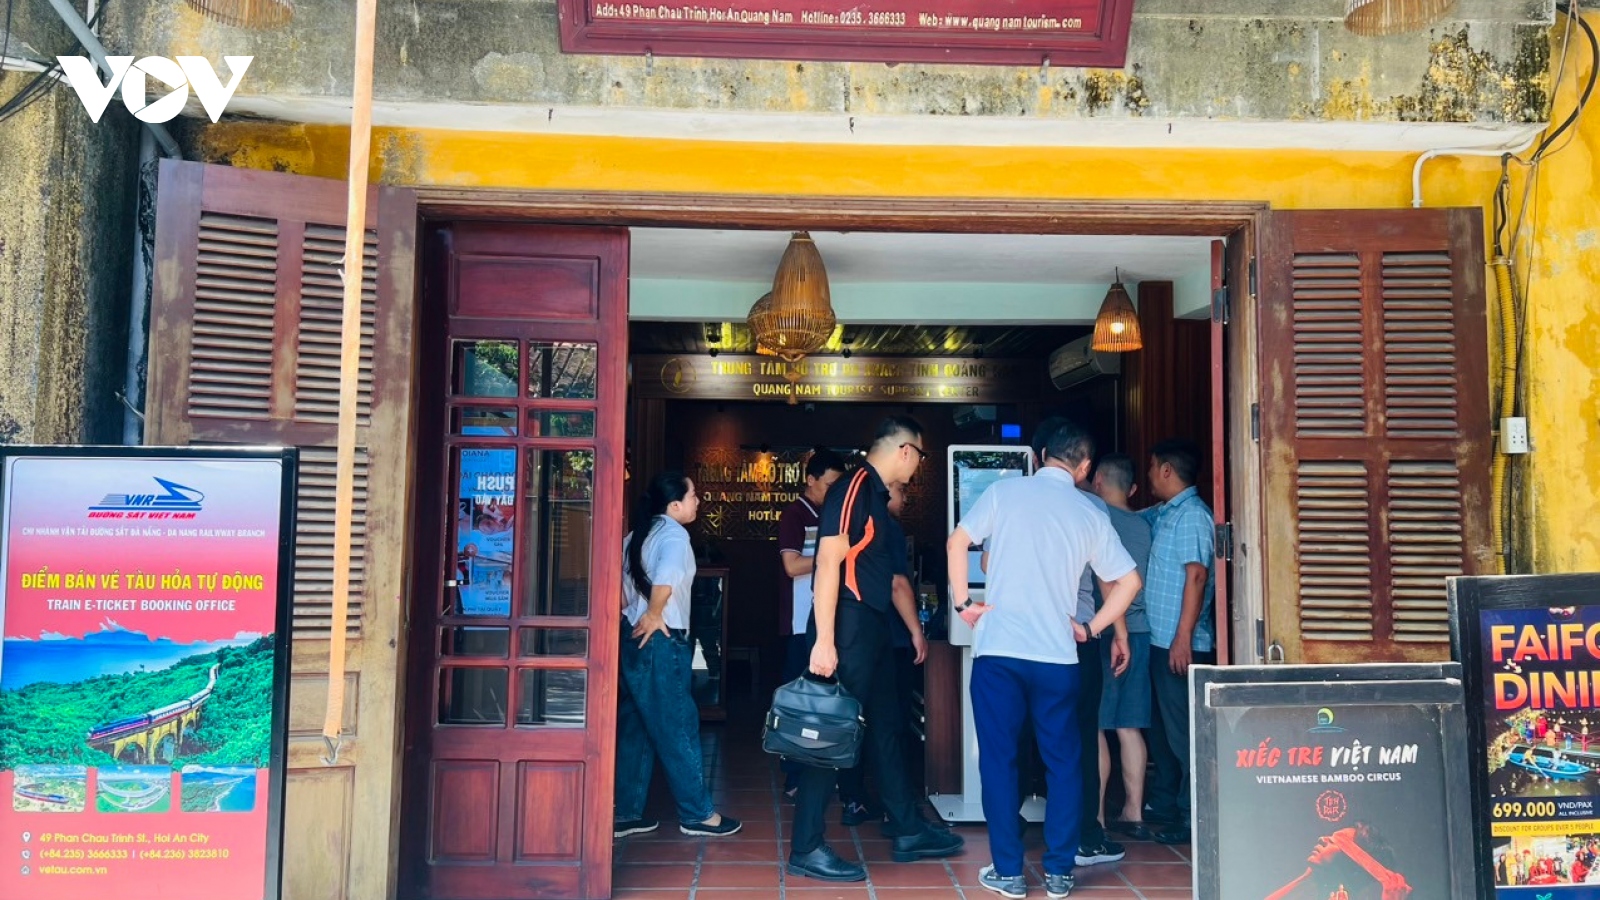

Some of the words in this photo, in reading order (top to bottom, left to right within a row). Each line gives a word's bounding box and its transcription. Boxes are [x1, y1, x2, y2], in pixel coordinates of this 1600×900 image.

[633, 5, 657, 19] Phan
[658, 5, 682, 19] Chau
[772, 10, 793, 23] Nam
[711, 361, 752, 375] TRUNG
[753, 383, 791, 396] QUANG
[795, 384, 821, 395] NAM
[125, 494, 155, 506] VNR
[237, 528, 266, 538] BRANCH
[21, 565, 60, 589] ĐIỂM
[65, 570, 96, 589] BÁN
[101, 570, 120, 589] VÉ
[126, 570, 156, 589] TÀU
[161, 568, 192, 590] HỎA
[196, 572, 218, 593] TỰ
[221, 570, 263, 593] ĐỘNG
[47, 599, 80, 611] TRAIN
[84, 599, 137, 611] E-TICKET
[141, 599, 193, 611] BOOKING
[195, 599, 236, 611] OFFICE
[1494, 670, 1600, 710] DINI
[1235, 736, 1282, 768] XIẾC
[1287, 745, 1324, 767] TRE
[1330, 739, 1372, 771] VIỆT
[1378, 743, 1419, 765] NAM
[1256, 774, 1319, 784] VIETNAMESE
[1321, 774, 1365, 783] BAMBOO
[1366, 772, 1402, 782] CIRCUS
[1493, 801, 1556, 818] 699.000
[1557, 801, 1593, 809] VND/PAX
[1494, 825, 1520, 833] DISCOUNT
[1533, 824, 1555, 832] GROUPS
[1555, 823, 1569, 831] OVER
[40, 833, 52, 843] 49
[54, 833, 79, 843] Phan
[82, 832, 109, 843] Chau
[111, 833, 134, 843] Trinh
[154, 833, 170, 843] Hoi
[172, 833, 187, 843] An
[189, 833, 209, 844] City
[40, 849, 84, 859] (+84.235)
[87, 849, 128, 859] 3666333
[139, 849, 185, 860] (+84.236)
[187, 848, 229, 859] 3823810
[40, 865, 108, 874] vetau.com.vn
